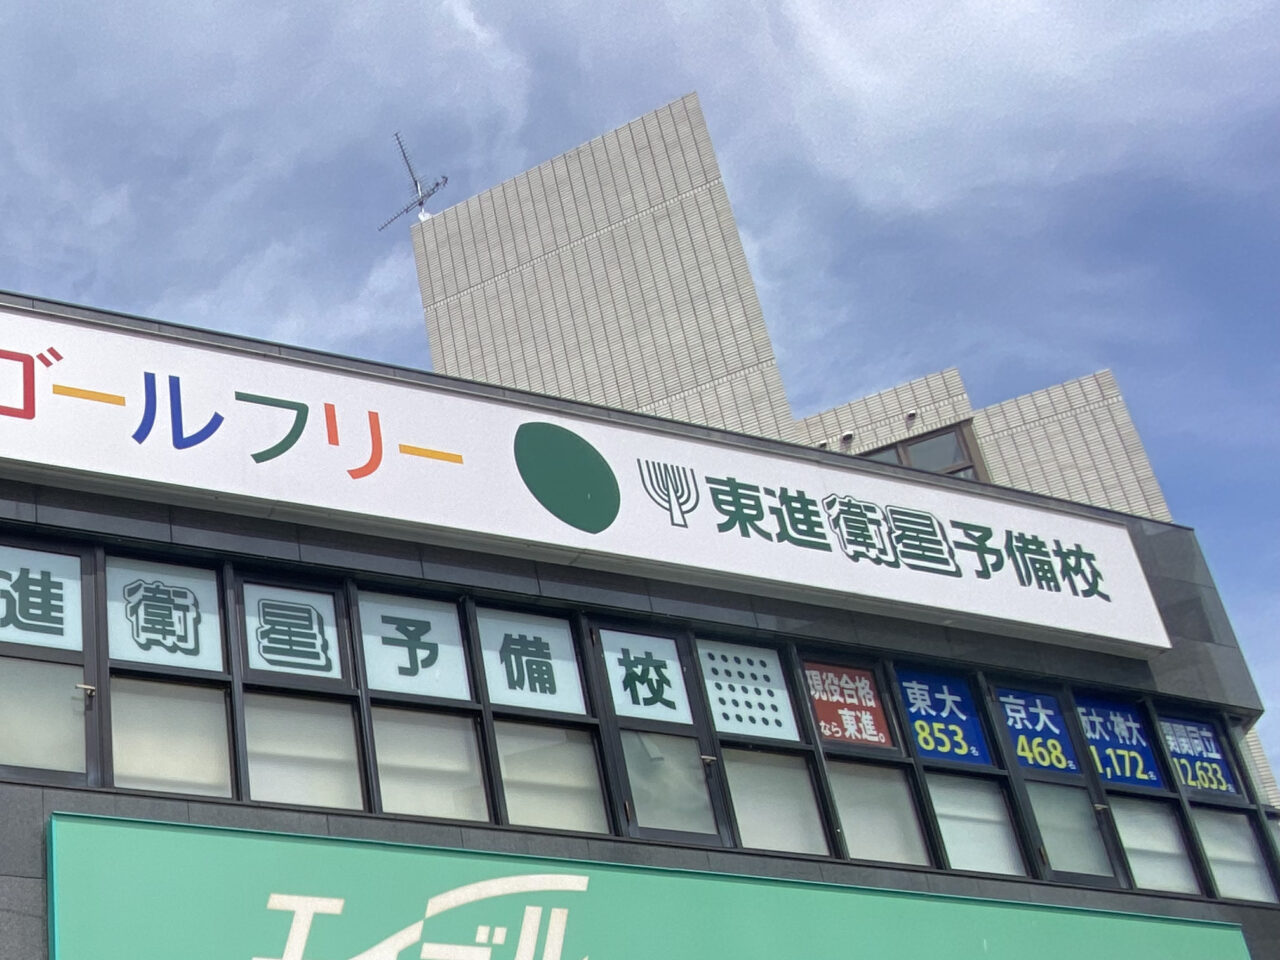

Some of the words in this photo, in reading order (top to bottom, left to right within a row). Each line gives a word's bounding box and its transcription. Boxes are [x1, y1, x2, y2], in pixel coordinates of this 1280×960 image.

[705, 476, 1112, 602] 東進衛星予備校
[806, 669, 877, 708] 現役合格
[902, 680, 967, 721] 東大
[999, 694, 1061, 735] 京大
